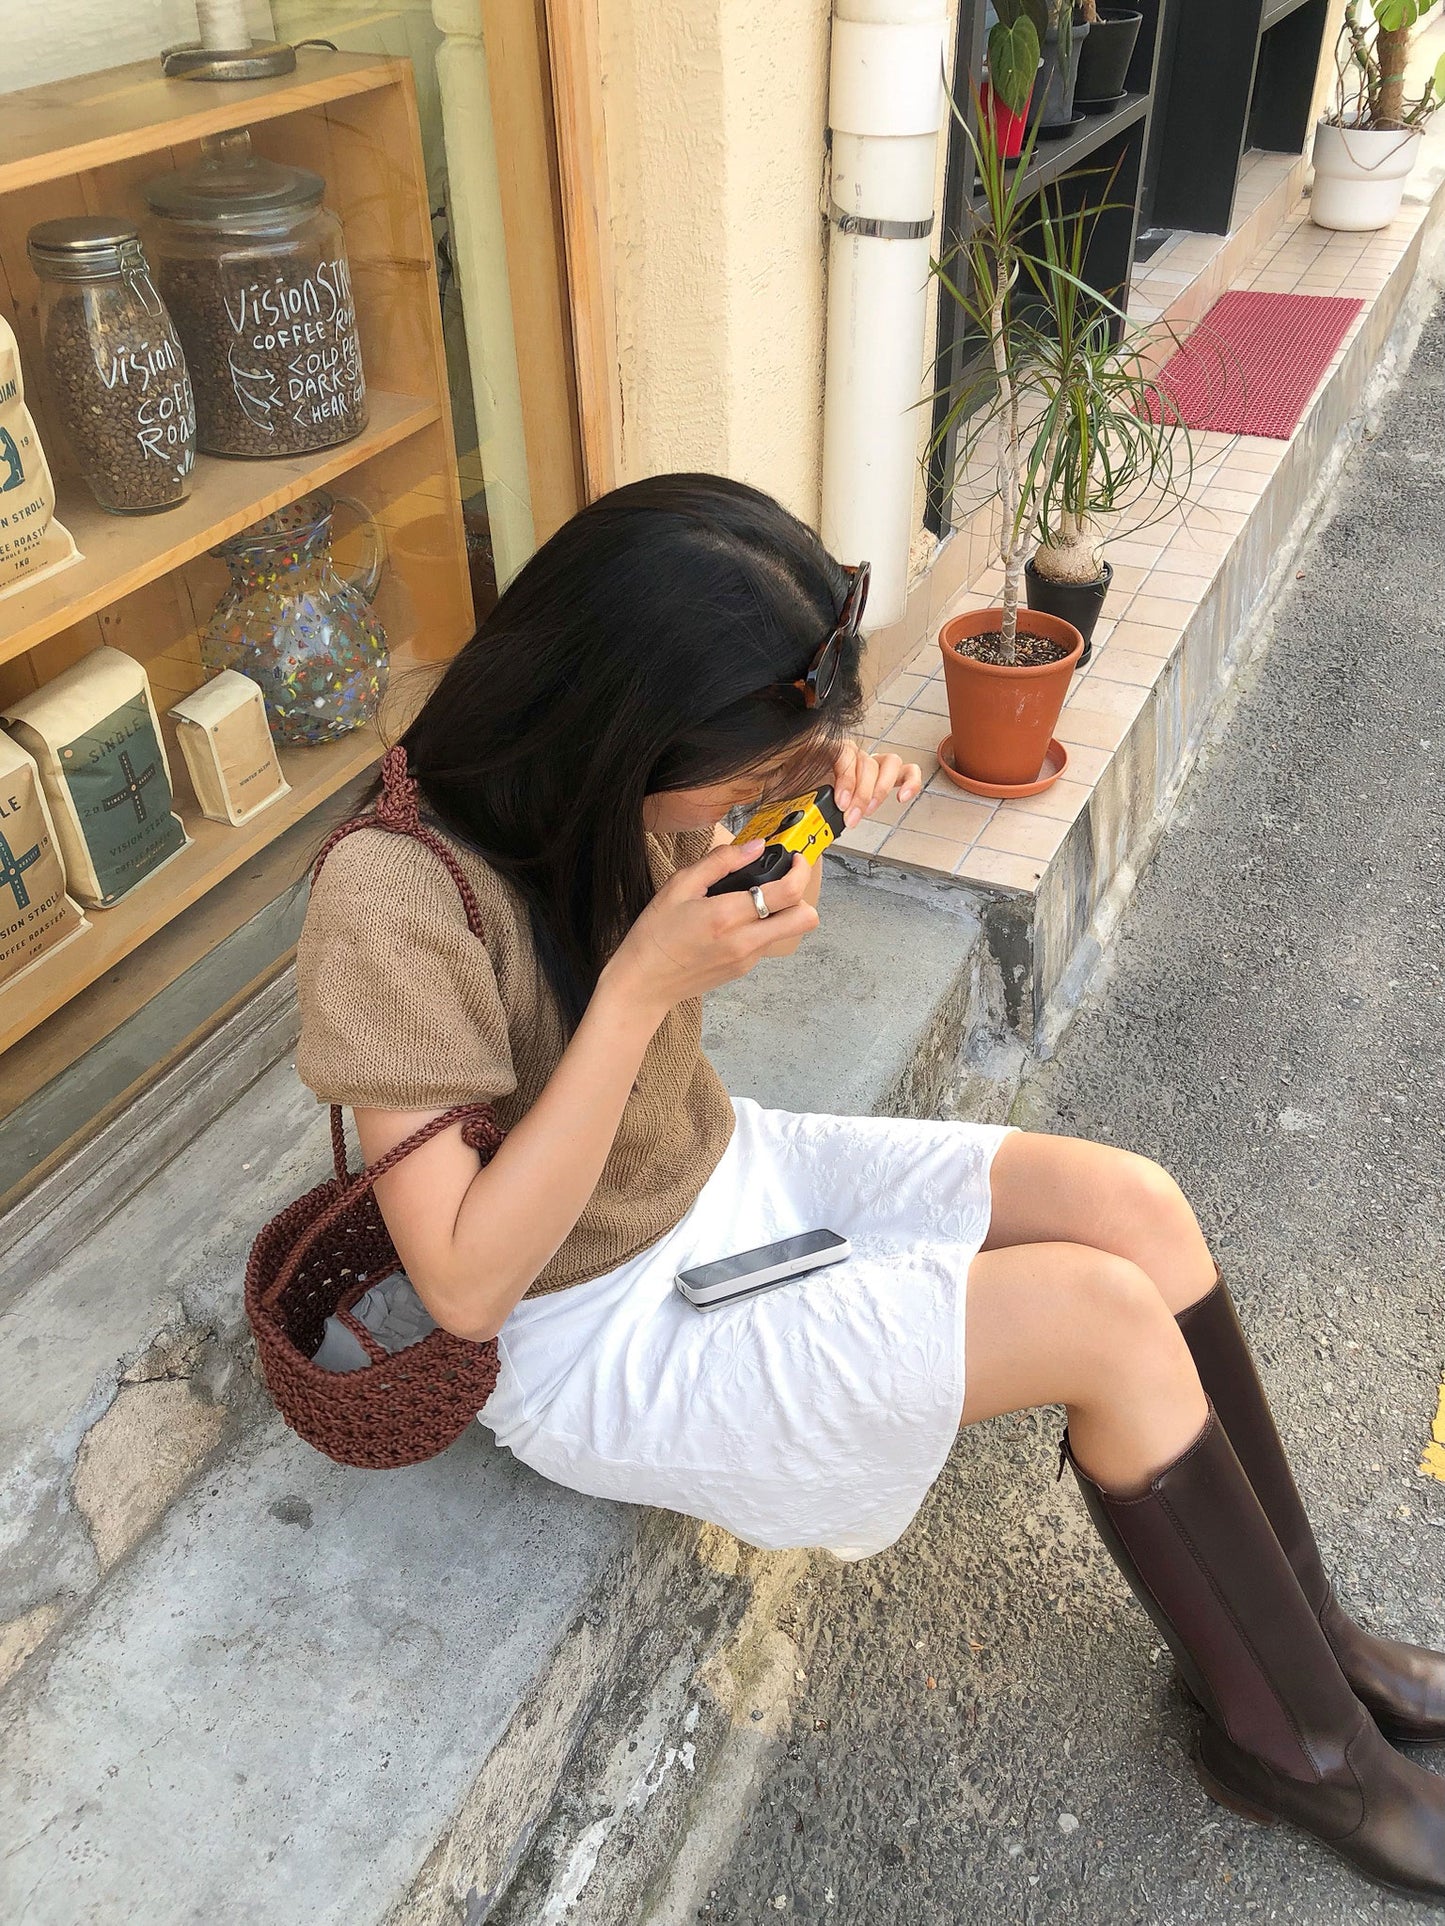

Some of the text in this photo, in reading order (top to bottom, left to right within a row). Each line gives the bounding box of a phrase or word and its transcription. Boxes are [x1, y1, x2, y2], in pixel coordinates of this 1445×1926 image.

[253, 321, 326, 349] COFFEE
[12, 496, 45, 524] STROLL
[0, 796, 22, 819] LE
[110, 831, 143, 857] VISION
[28, 891, 60, 922] STROLL
[28, 907, 67, 942] ROASTERS
